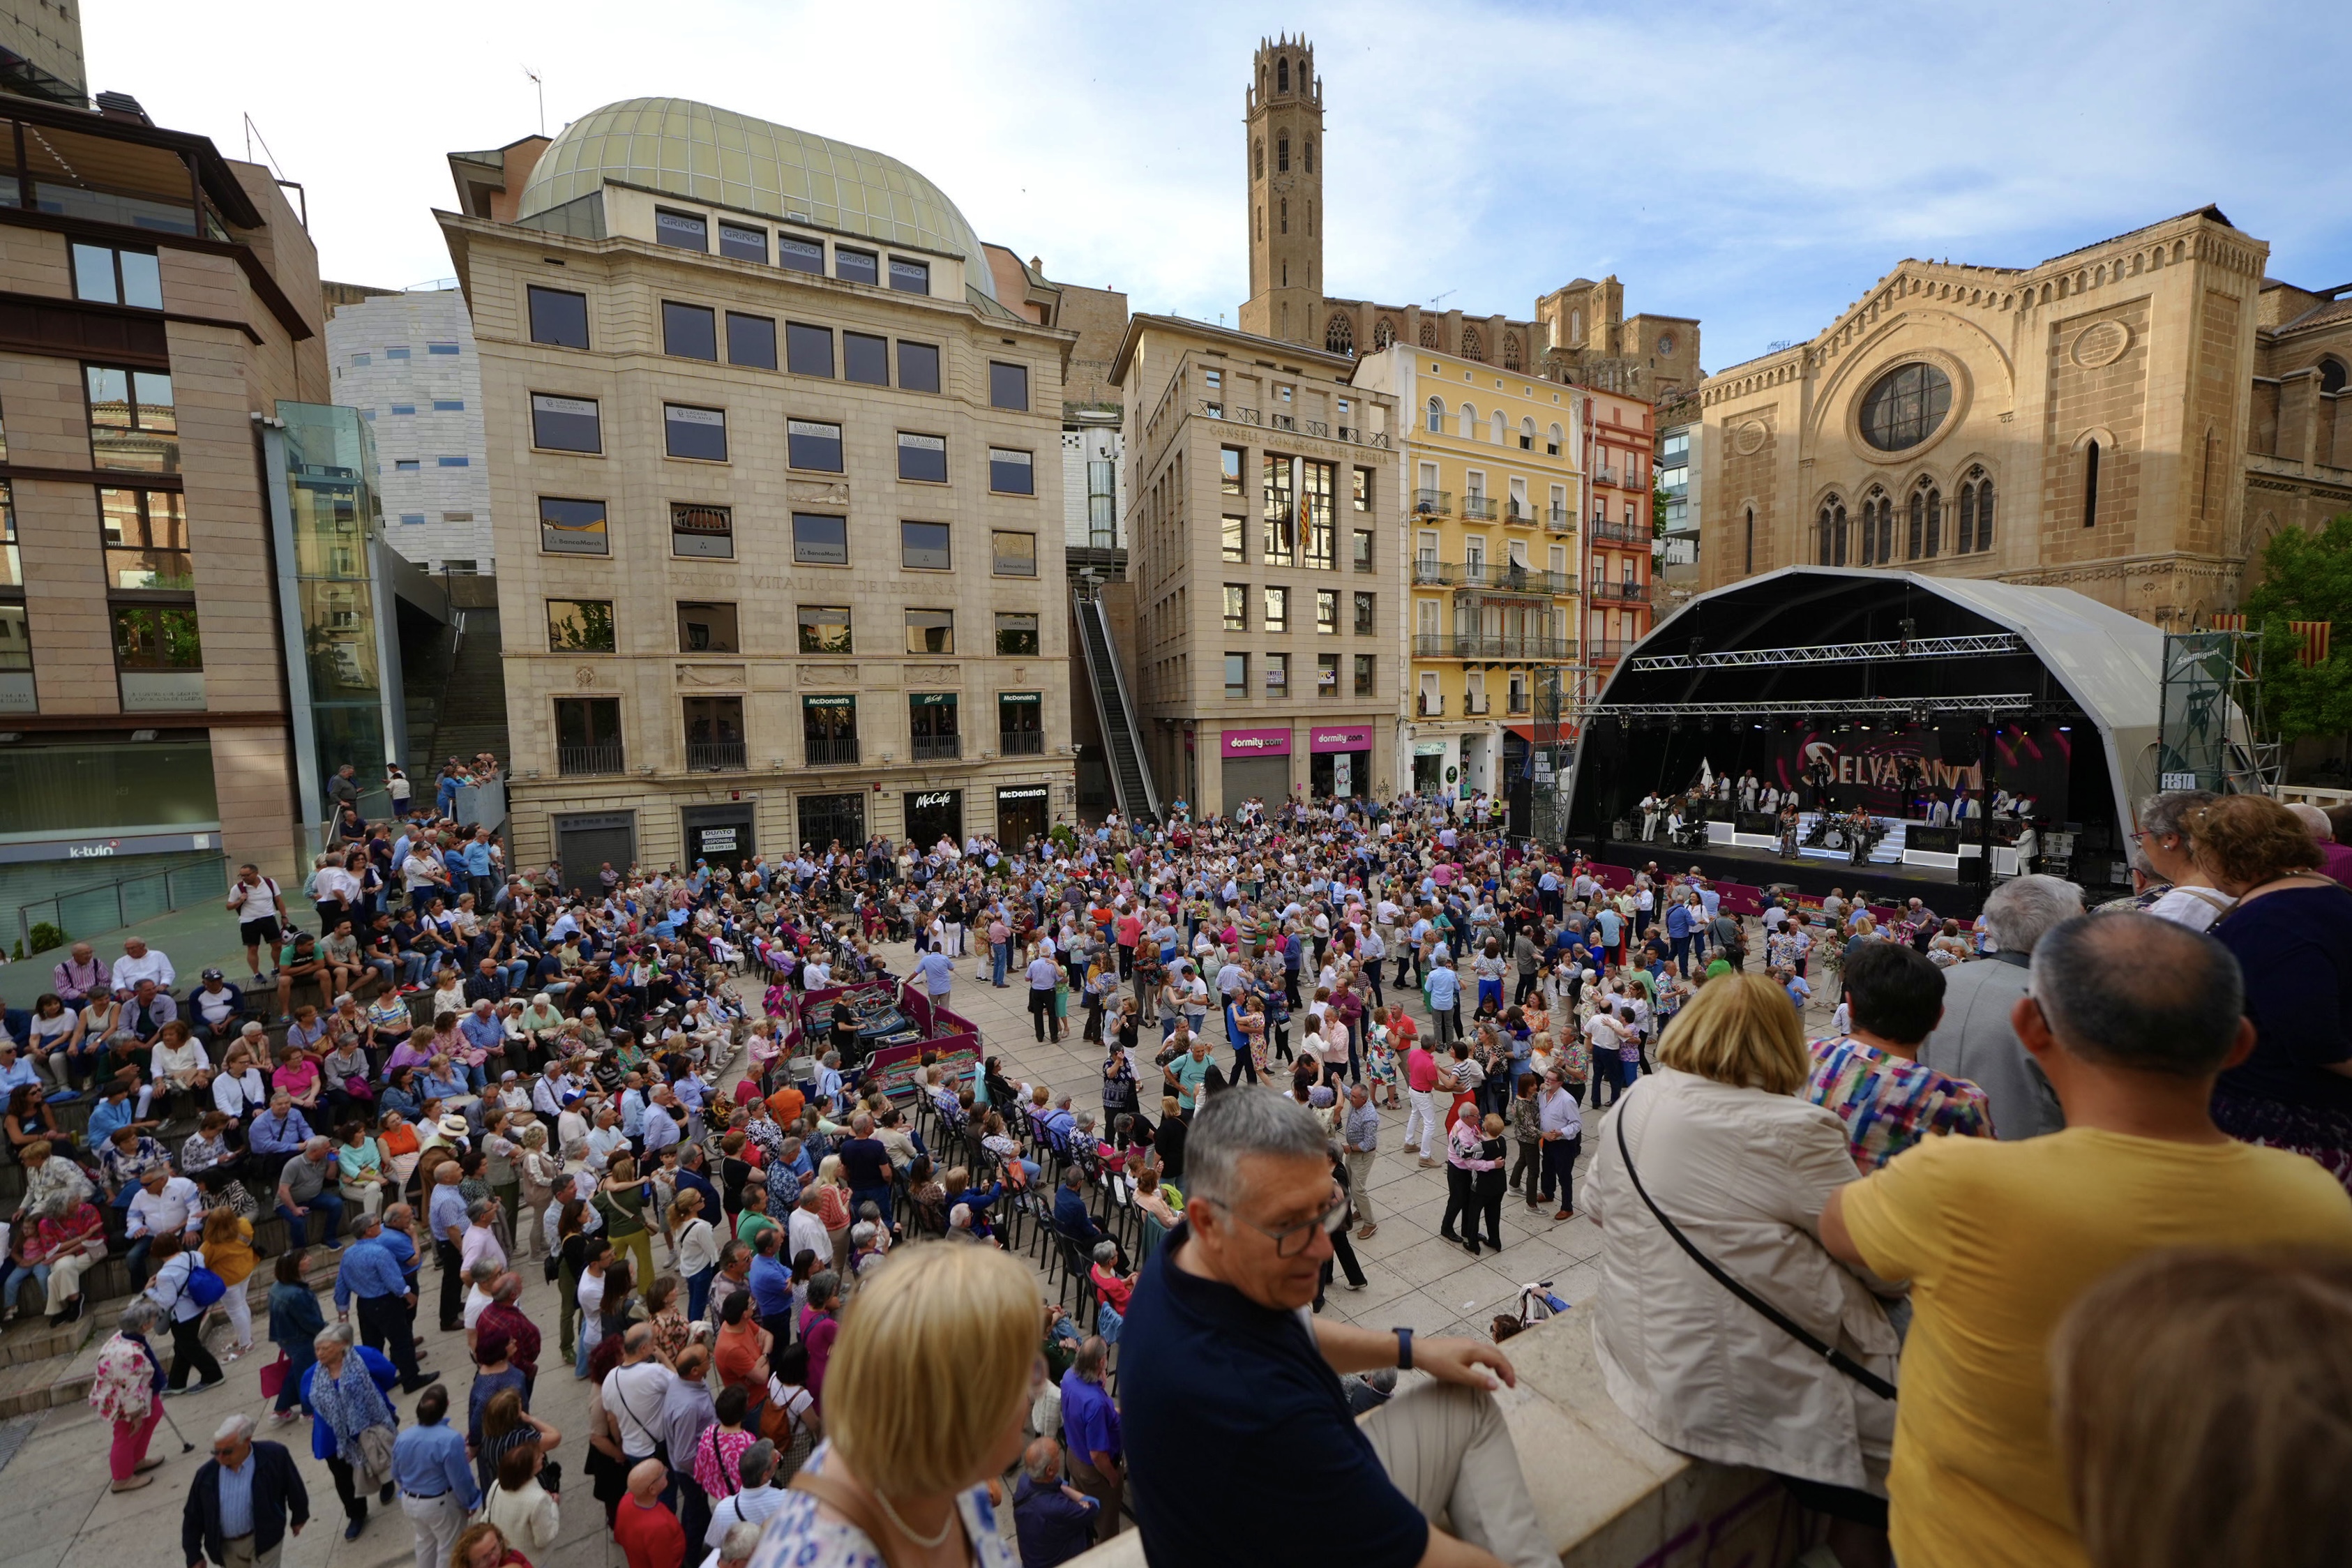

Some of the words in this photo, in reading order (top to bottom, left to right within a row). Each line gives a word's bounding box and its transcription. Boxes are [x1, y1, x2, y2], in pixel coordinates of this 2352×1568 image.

[808, 424, 834, 432] RAMON
[916, 437, 939, 445] RAMON
[1209, 424, 1260, 442] CONSELL
[1267, 434, 1325, 455] COMARCAL
[1332, 445, 1349, 458] DEL
[1355, 448, 1389, 465] SEGRIÀ
[668, 571, 737, 588] BANCO
[751, 575, 845, 591] VITALICIO
[857, 580, 877, 593] DE
[890, 581, 958, 596] ESPAÑA
[1357, 596, 1370, 610] UOC
[809, 697, 850, 705] McDonald's
[1230, 737, 1283, 748] dormity.com
[1318, 733, 1362, 744] dormity.com
[1801, 741, 1984, 790] SELVAANA
[2161, 773, 2196, 790] FESTA
[1000, 788, 1046, 799] McDonald's
[70, 844, 114, 859] k-tuin
